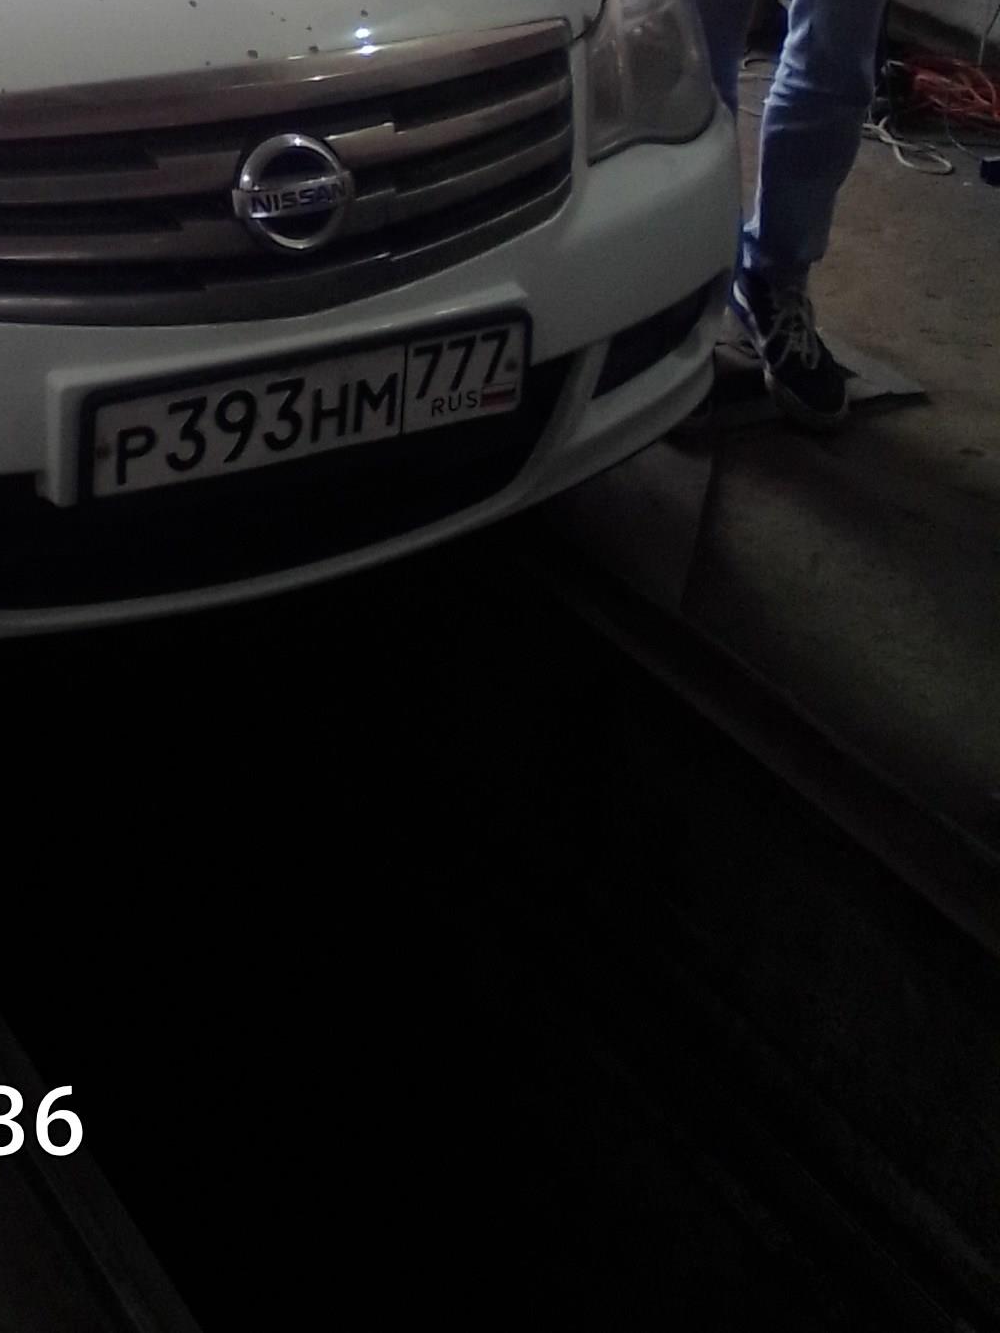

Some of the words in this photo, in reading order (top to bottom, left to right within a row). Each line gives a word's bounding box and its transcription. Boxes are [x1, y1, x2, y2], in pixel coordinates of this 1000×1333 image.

[250, 181, 346, 214] NISSAN
[413, 329, 511, 400] 777
[430, 391, 479, 417] RUS
